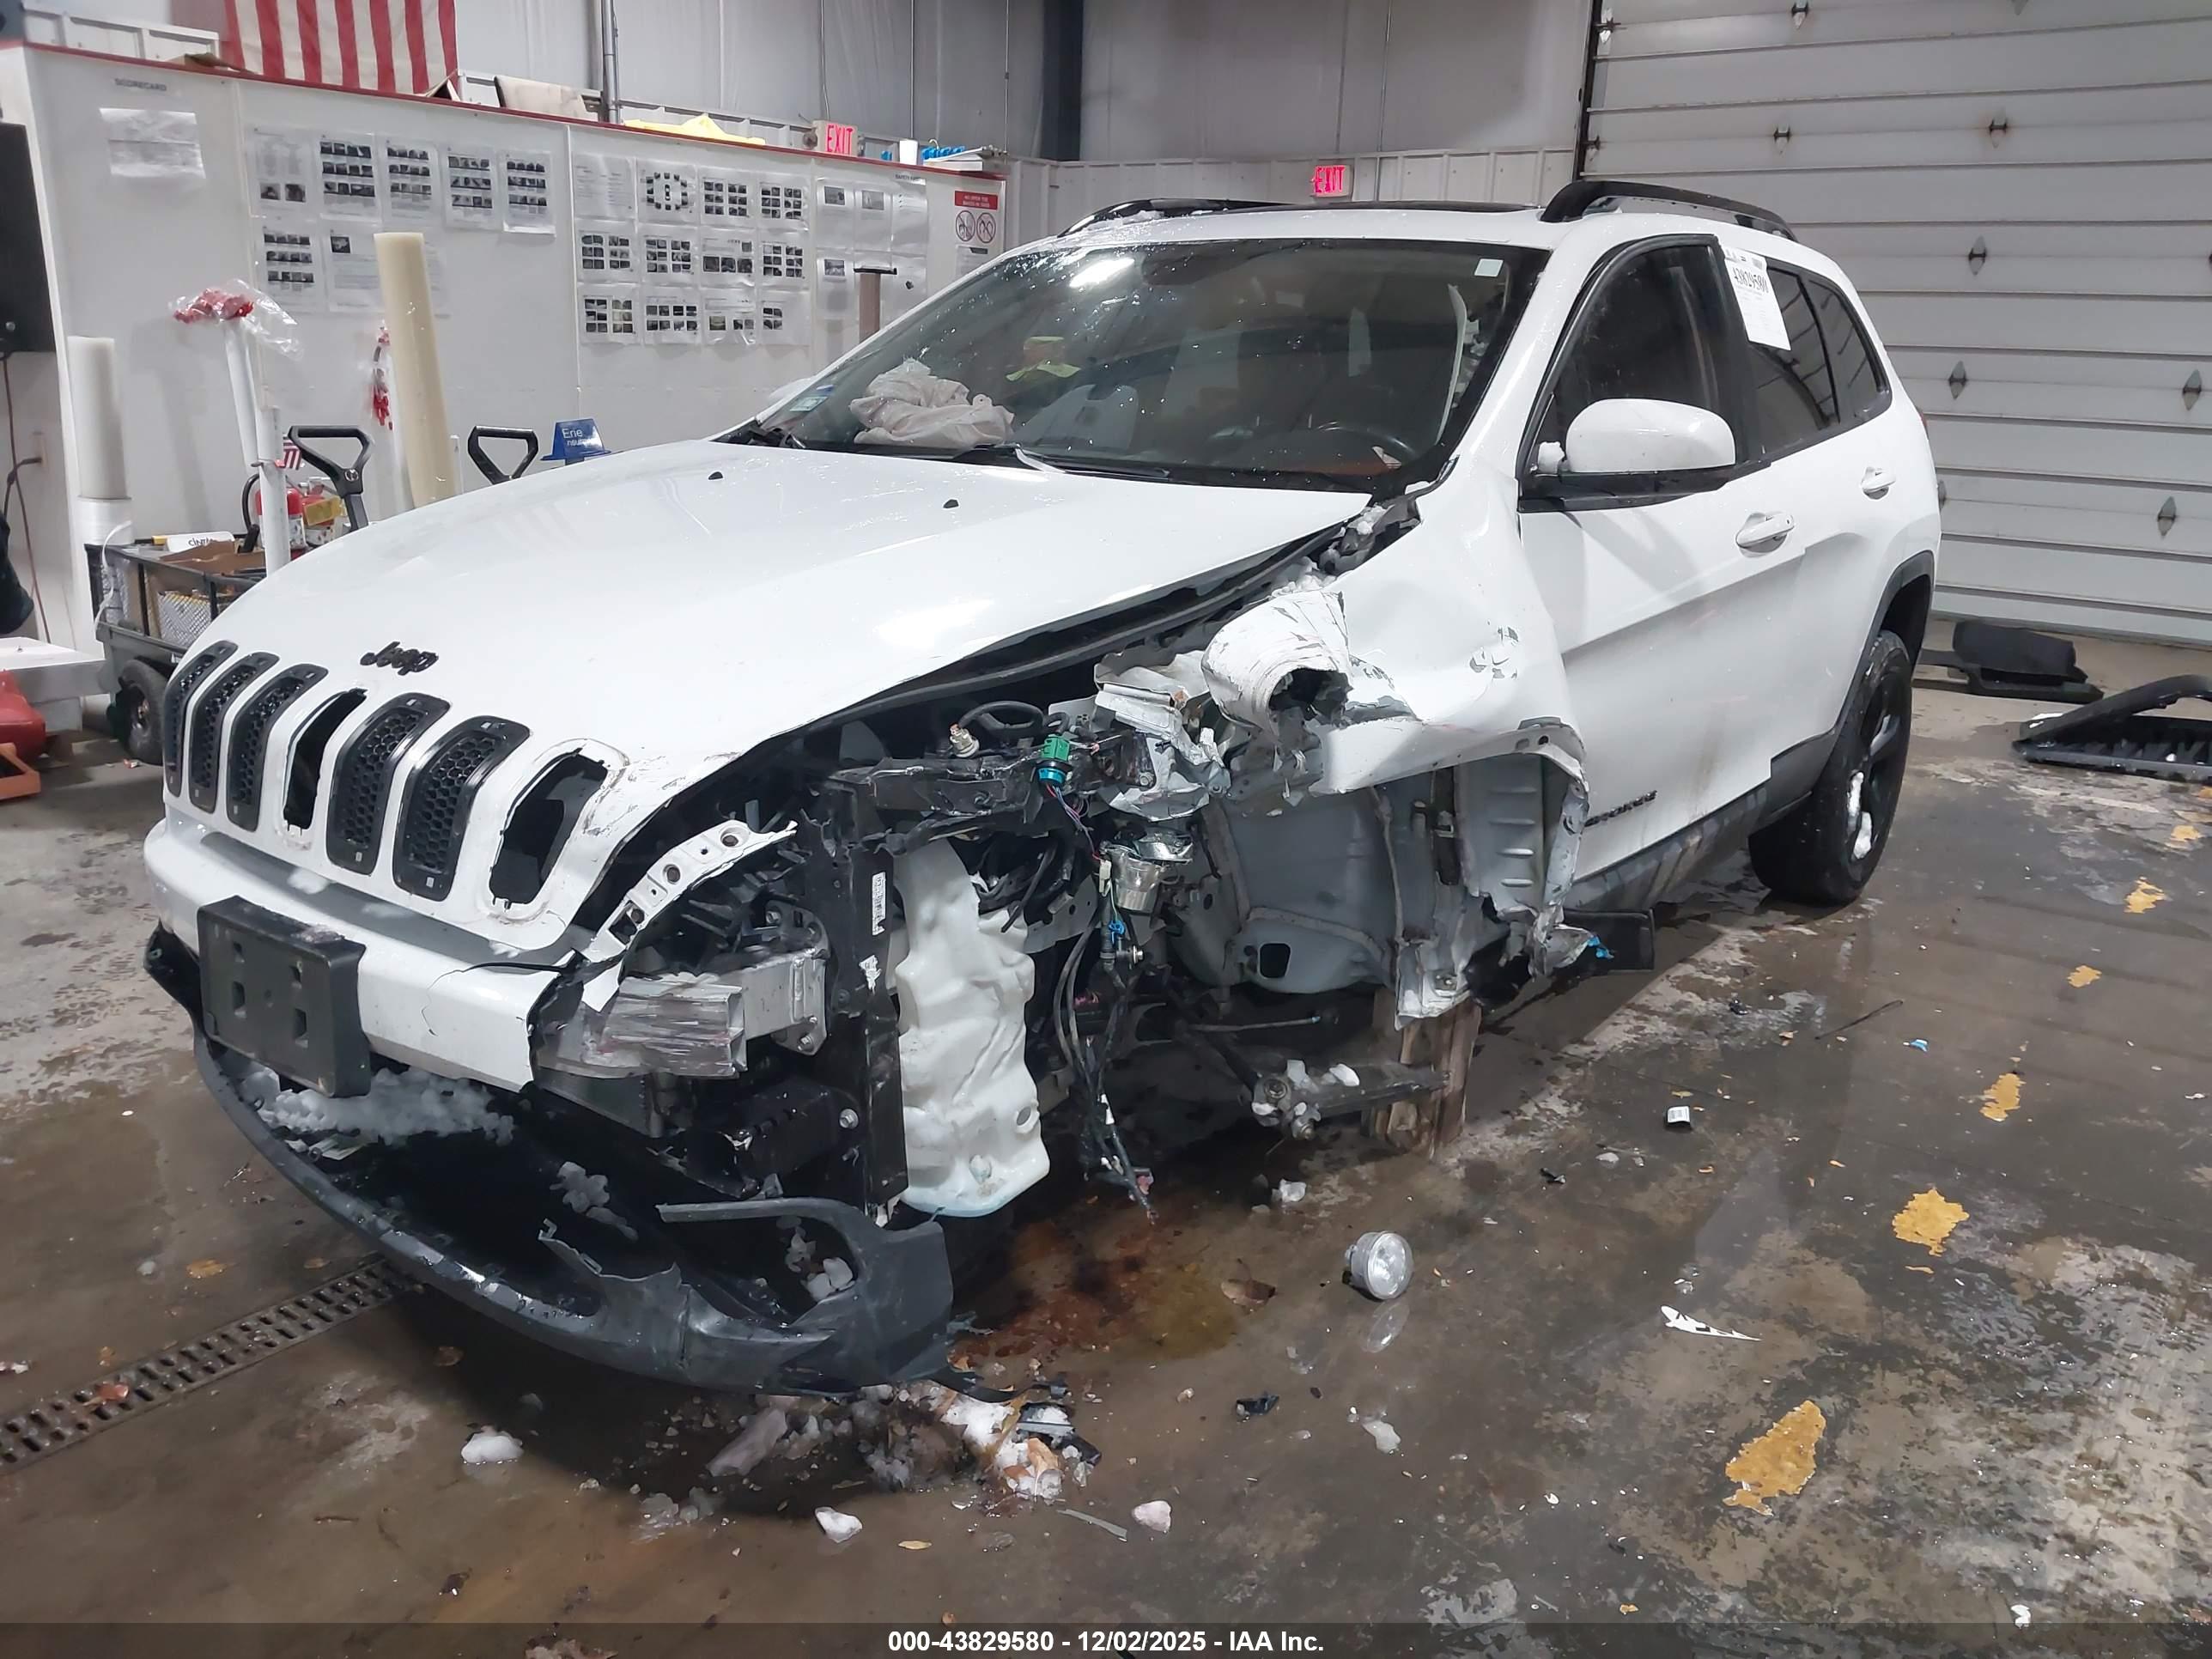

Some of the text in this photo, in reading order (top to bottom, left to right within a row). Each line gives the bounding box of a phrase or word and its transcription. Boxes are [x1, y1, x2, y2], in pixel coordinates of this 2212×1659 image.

[827, 125, 853, 155] EXIT
[1315, 166, 1345, 192] EXIT
[562, 428, 583, 439] Erie
[360, 641, 439, 676] Jeep
